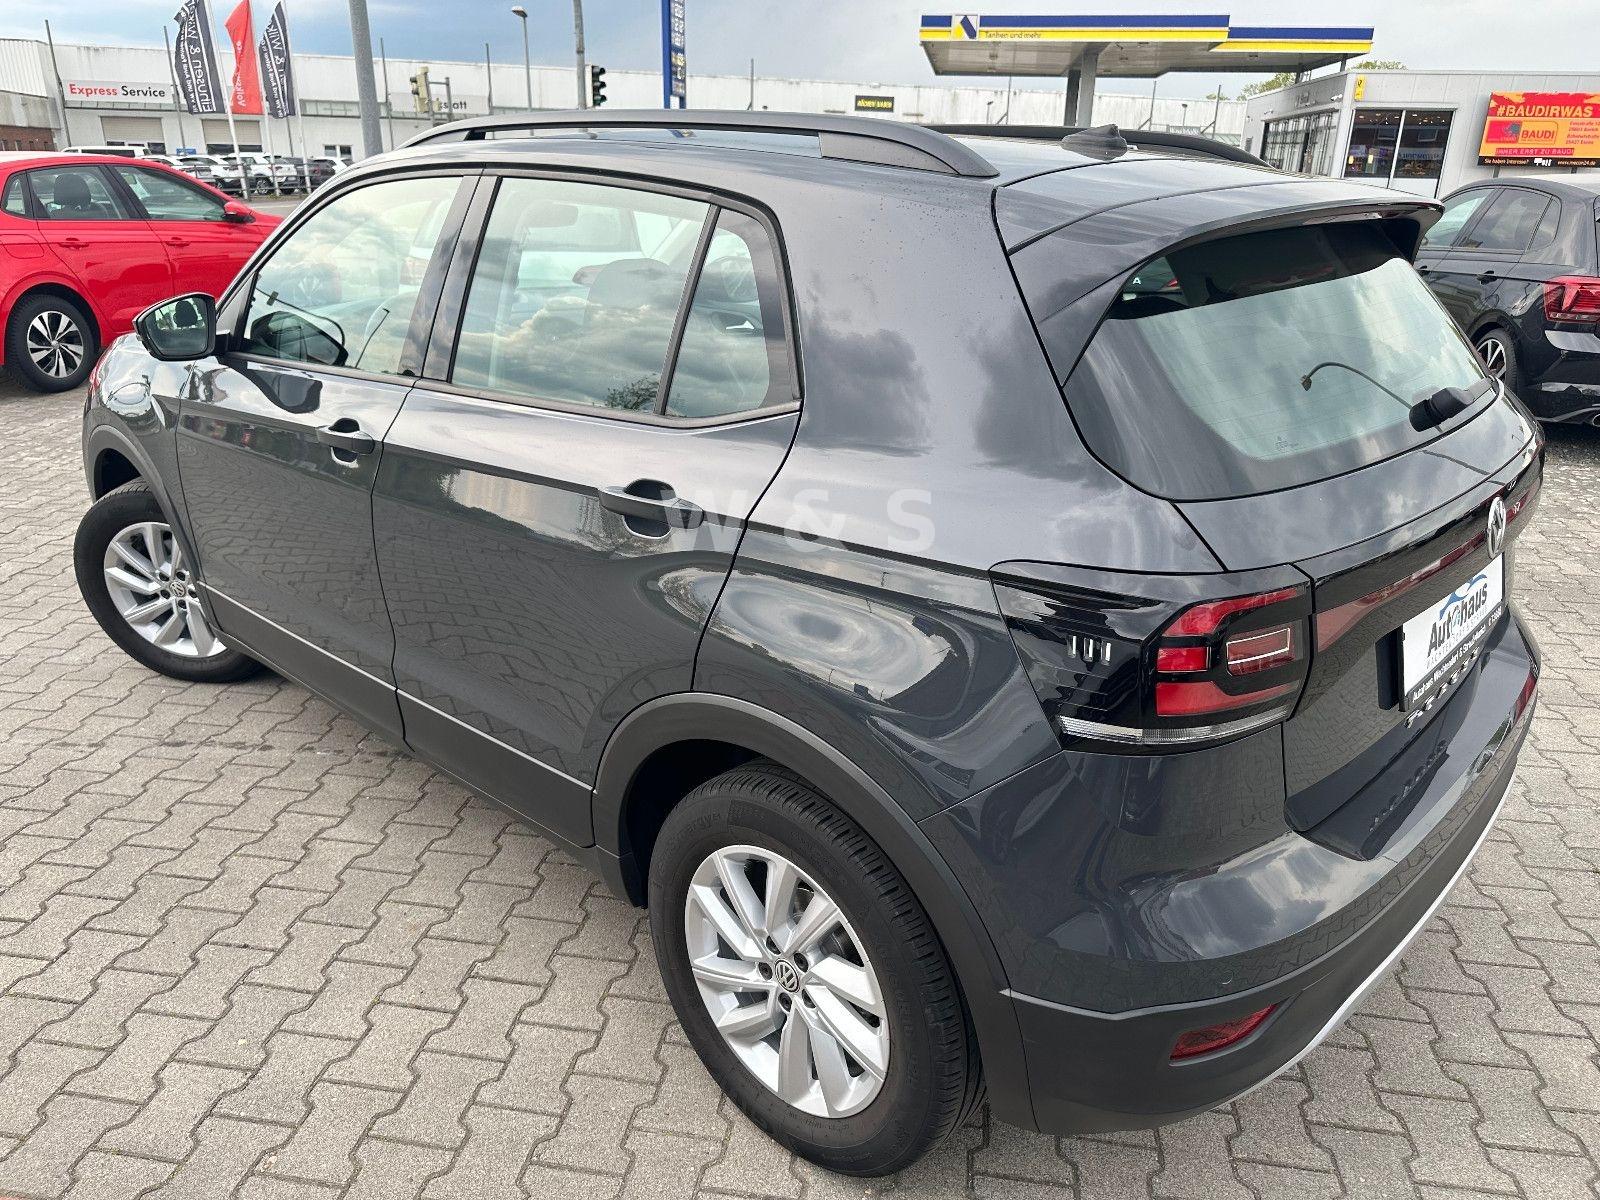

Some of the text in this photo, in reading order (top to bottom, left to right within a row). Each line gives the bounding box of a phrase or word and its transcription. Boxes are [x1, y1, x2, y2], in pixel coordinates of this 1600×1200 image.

[69, 83, 166, 97] Express Service
[1496, 105, 1594, 117] #BAUDIRWAS
[1521, 129, 1555, 139] BAUDI
[1428, 583, 1488, 658] Autohaus
